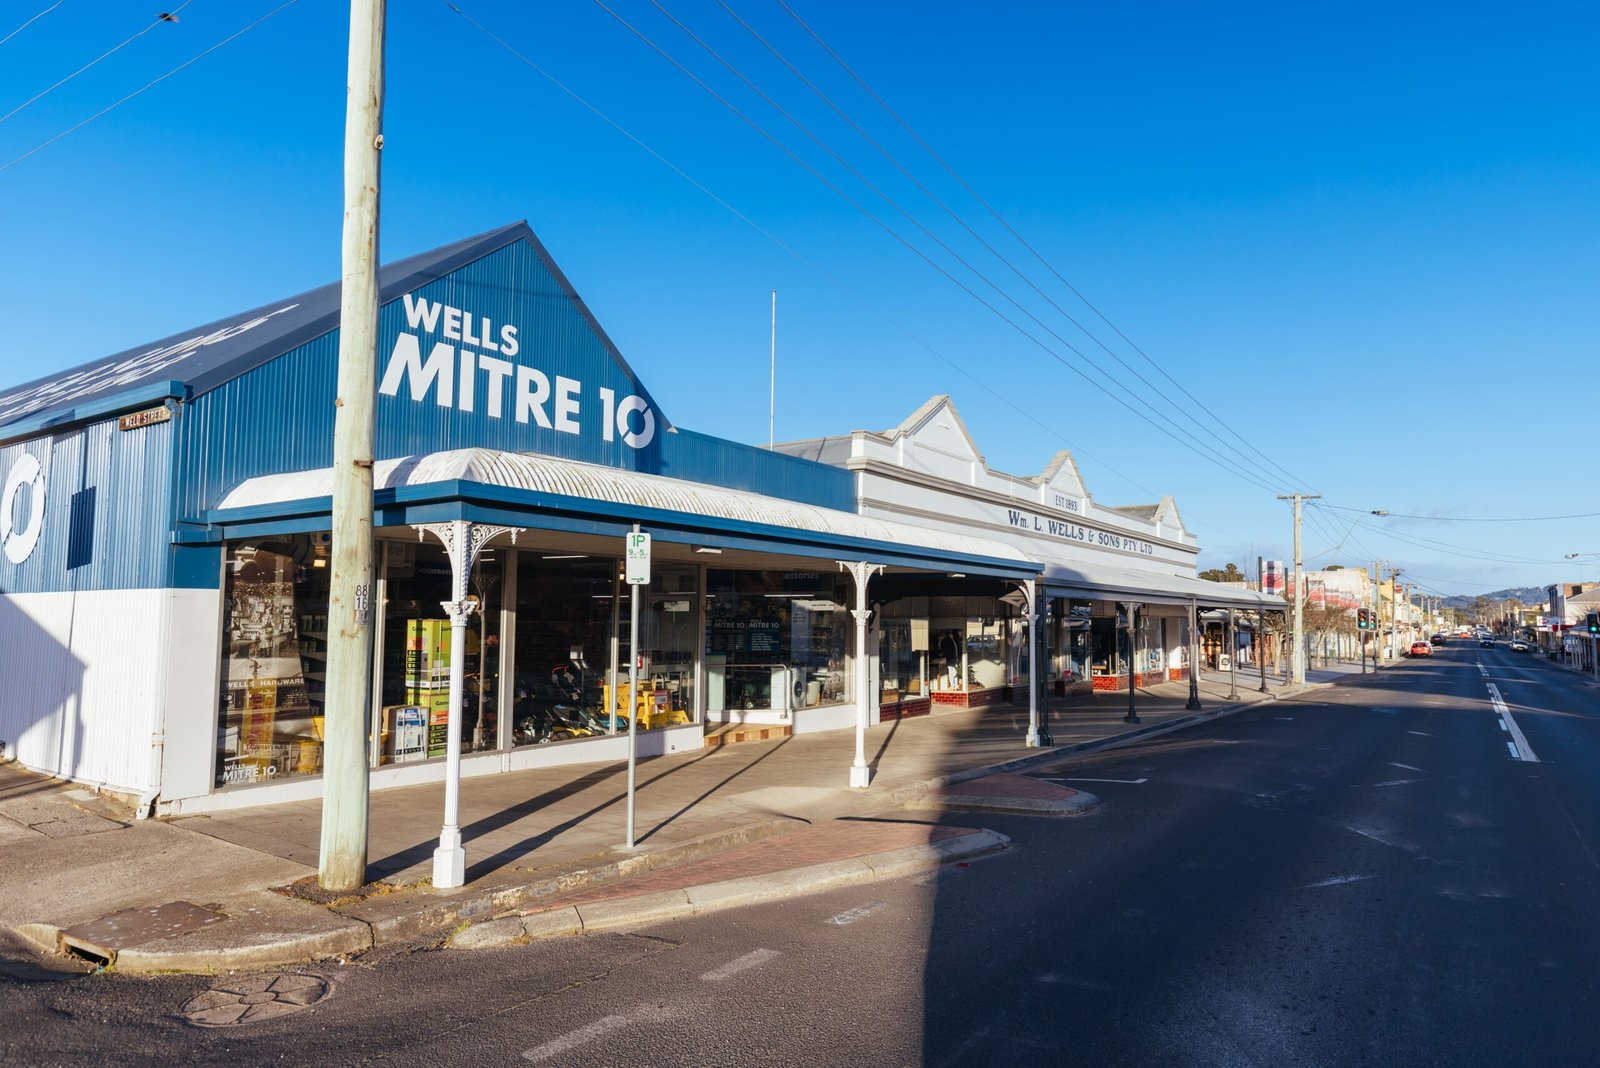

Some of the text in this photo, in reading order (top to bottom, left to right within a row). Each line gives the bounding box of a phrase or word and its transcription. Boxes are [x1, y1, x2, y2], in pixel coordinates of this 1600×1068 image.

[403, 293, 519, 356] WELLS
[379, 332, 655, 449] MITRE 10
[143, 409, 166, 424] STREET
[1008, 510, 1153, 555] Wm. L. WELLS & SONS PTY LTD
[632, 534, 646, 547] 1P
[355, 584, 368, 597] 88
[356, 597, 368, 610] 16
[260, 678, 305, 686] HARDWARE
[222, 765, 277, 782] MITRE 10
